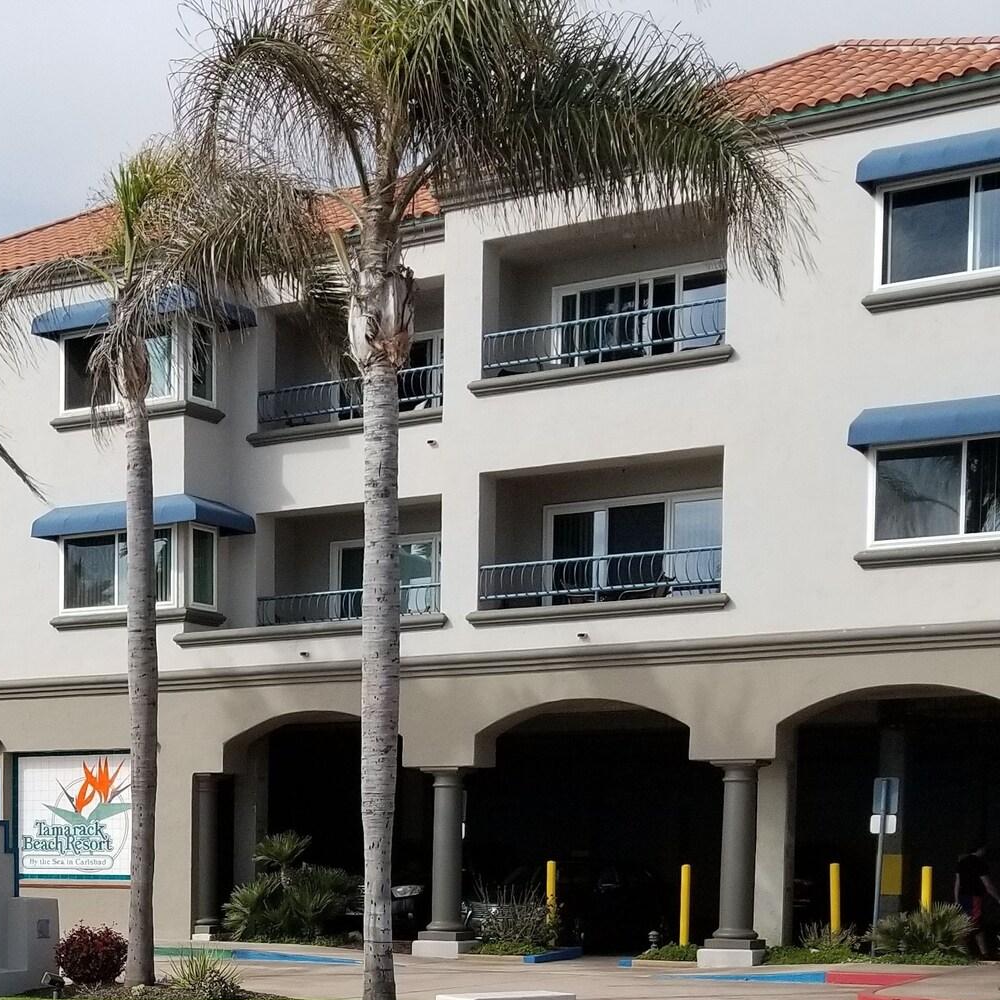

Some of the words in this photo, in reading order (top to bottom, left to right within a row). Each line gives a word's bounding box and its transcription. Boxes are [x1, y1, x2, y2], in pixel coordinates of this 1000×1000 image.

[34, 821, 108, 841] Tamarack
[23, 834, 66, 855] Beach
[65, 834, 114, 855] Resort
[75, 857, 107, 866] Carlsbad
